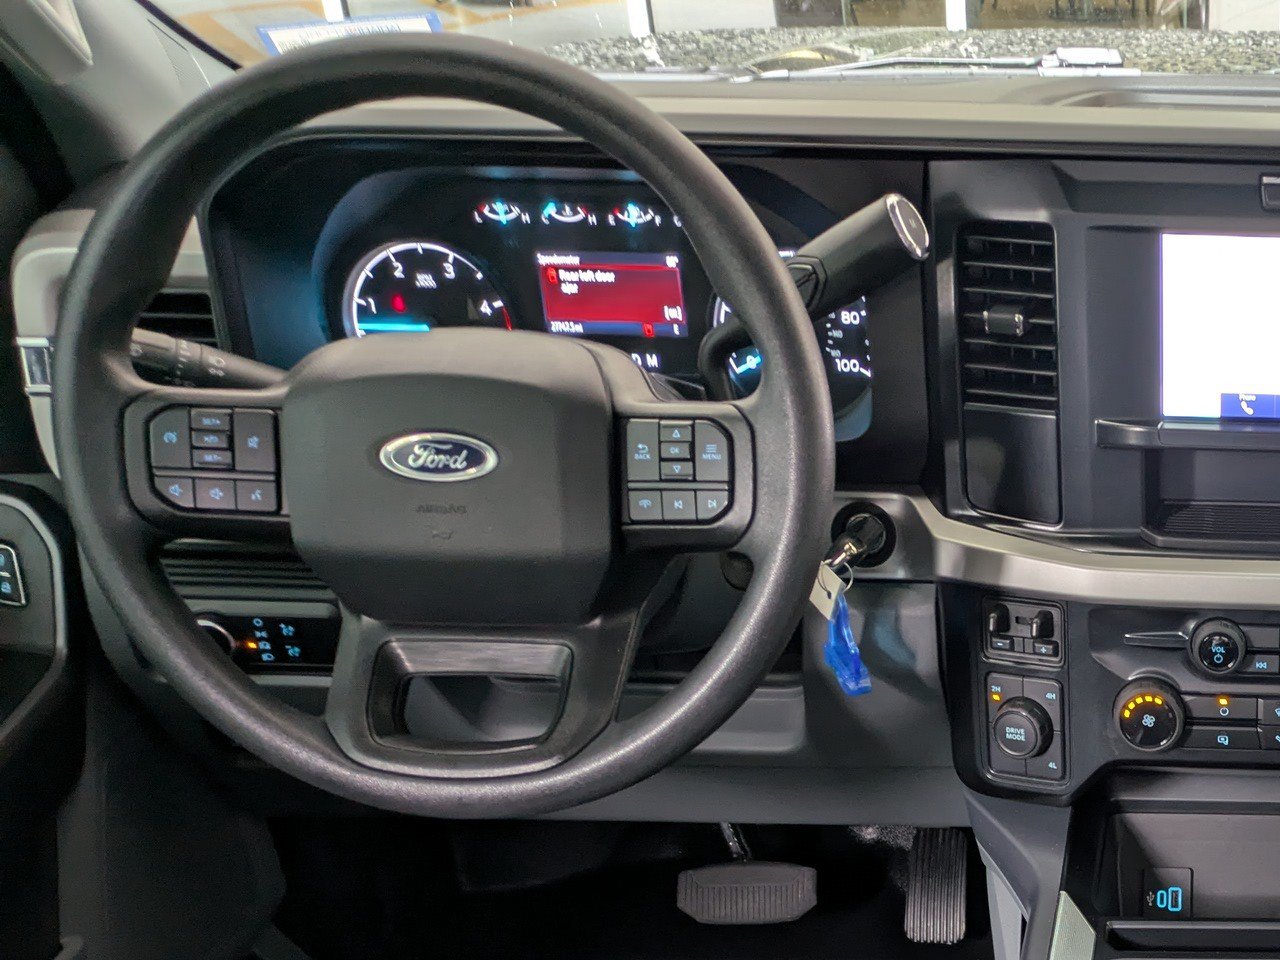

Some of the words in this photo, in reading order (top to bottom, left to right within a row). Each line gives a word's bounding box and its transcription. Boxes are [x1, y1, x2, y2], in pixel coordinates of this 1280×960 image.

[521, 212, 531, 224] H
[588, 214, 598, 226] H
[393, 262, 405, 278] 2
[443, 263, 455, 279] 3
[558, 269, 579, 282] Rear
[595, 270, 615, 283] door
[368, 298, 377, 314] 1
[480, 300, 492, 316] 4
[841, 311, 860, 325] 80
[646, 353, 658, 368] M
[835, 358, 860, 373] 100
[407, 442, 469, 469] Ford
[1211, 646, 1226, 654] VOL
